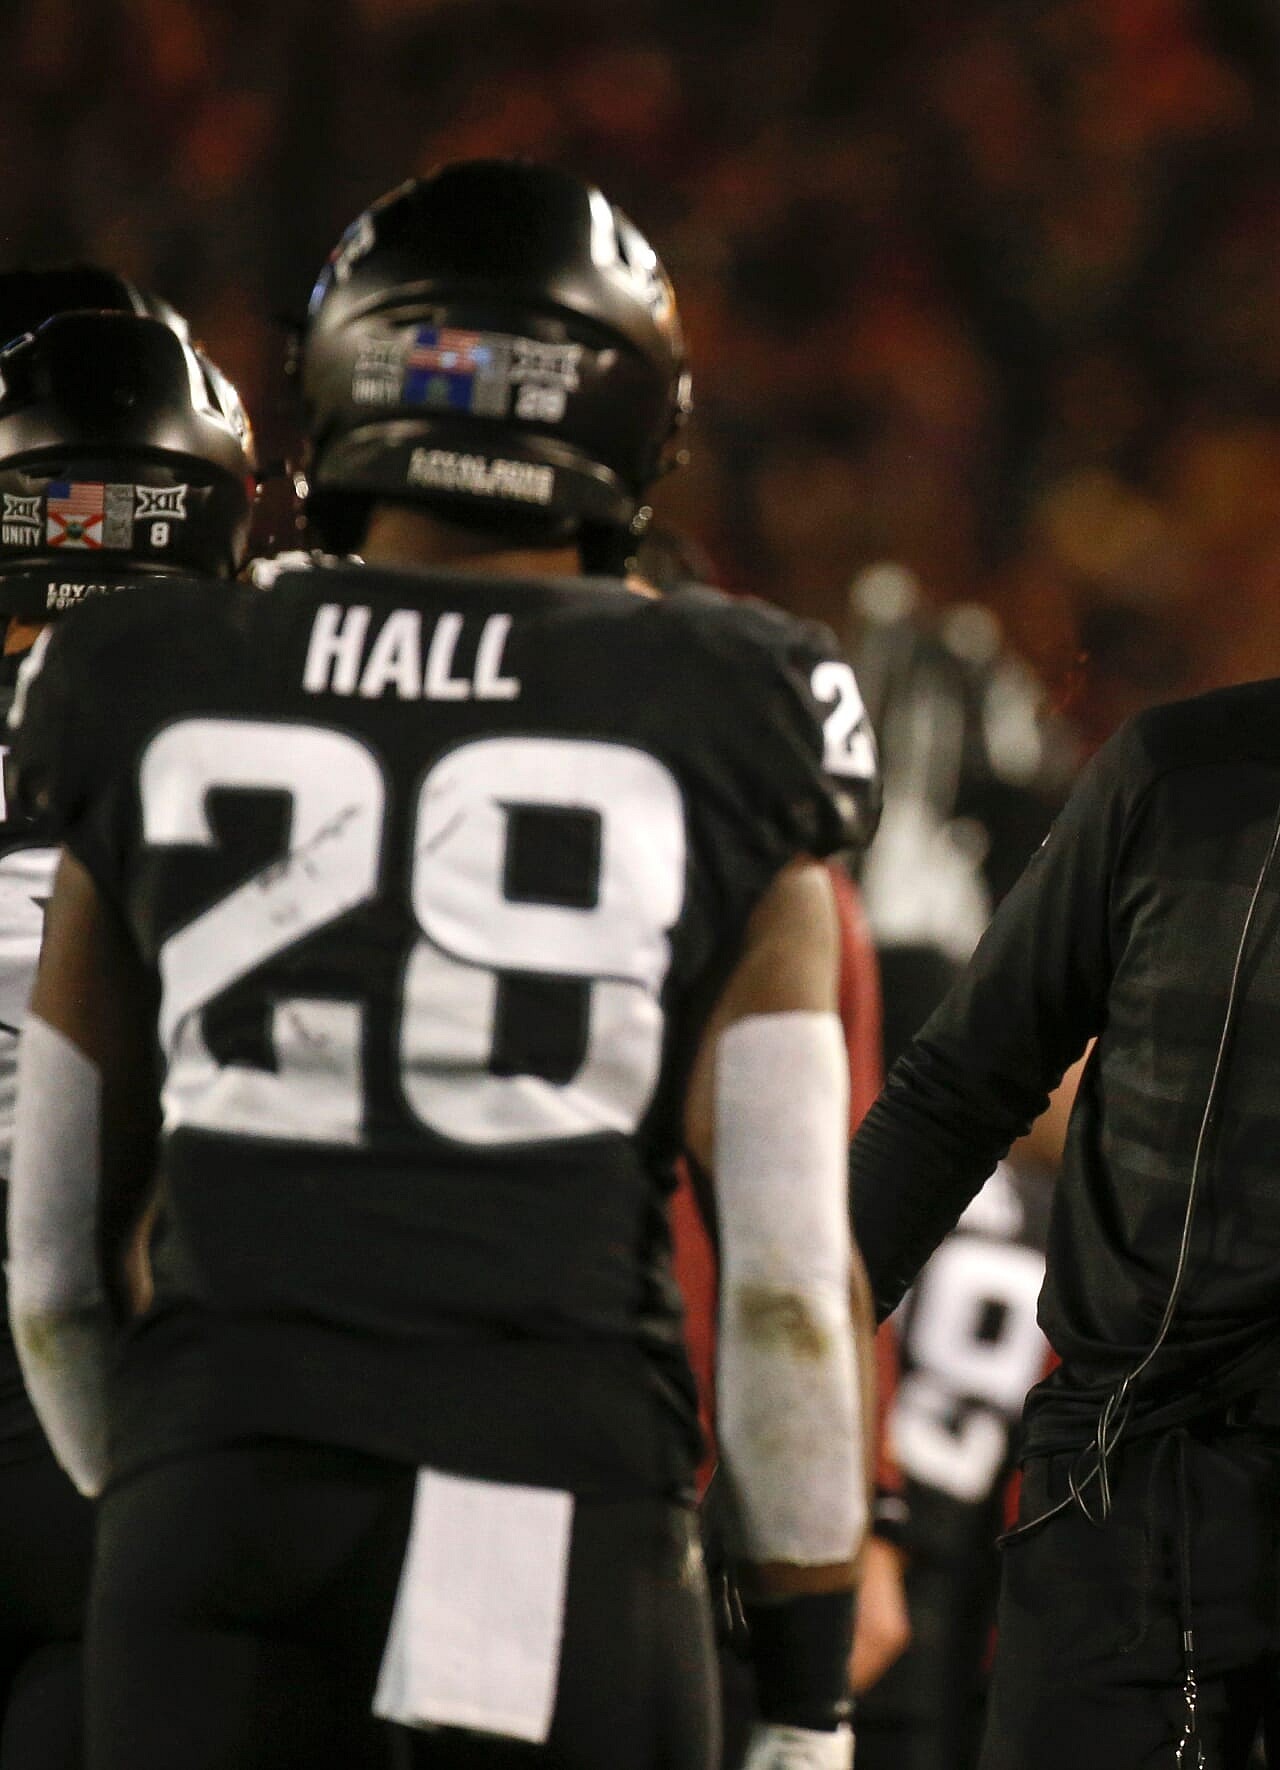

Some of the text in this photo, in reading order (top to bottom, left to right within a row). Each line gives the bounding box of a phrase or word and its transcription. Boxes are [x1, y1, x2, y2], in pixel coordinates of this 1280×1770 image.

[2, 525, 41, 547] UNITY
[150, 521, 170, 547] 8
[302, 603, 521, 702] HALL
[138, 717, 687, 1147] 28
